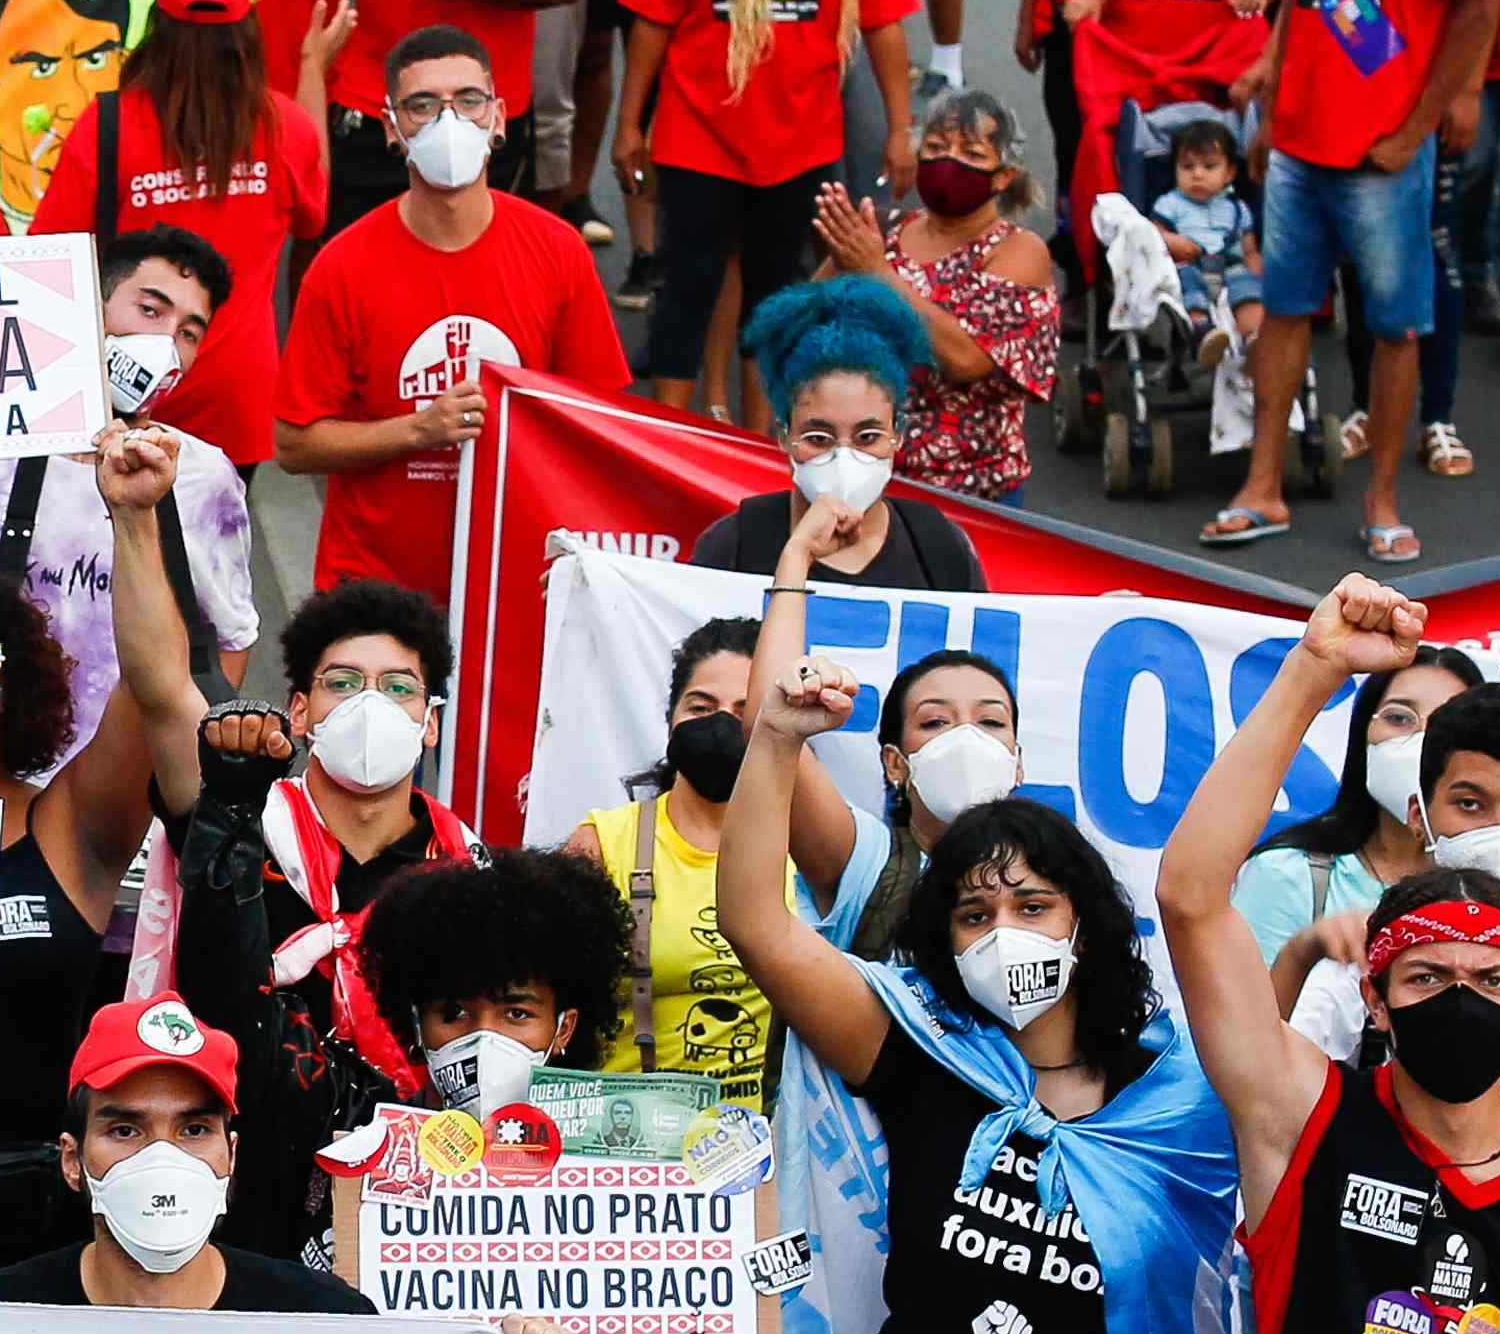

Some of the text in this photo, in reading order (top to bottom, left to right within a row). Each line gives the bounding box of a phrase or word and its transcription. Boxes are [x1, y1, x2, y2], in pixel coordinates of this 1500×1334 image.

[131, 192, 147, 208] O
[435, 1061, 467, 1094] FORA
[529, 1079, 602, 1102] QUEM VOCÊ
[580, 1097, 605, 1116] POR
[686, 1126, 731, 1161] NÃO
[151, 1193, 176, 1208] 3M
[379, 1193, 733, 1237] COMIDA NO PRATO
[1343, 1181, 1402, 1220] FORA
[1360, 1210, 1419, 1239] BOLSONARO
[939, 1214, 1032, 1275] fora
[744, 1244, 799, 1283] FORA
[1432, 1269, 1472, 1289] MATAR
[380, 1265, 734, 1317] VACINA NO BRAÇO
